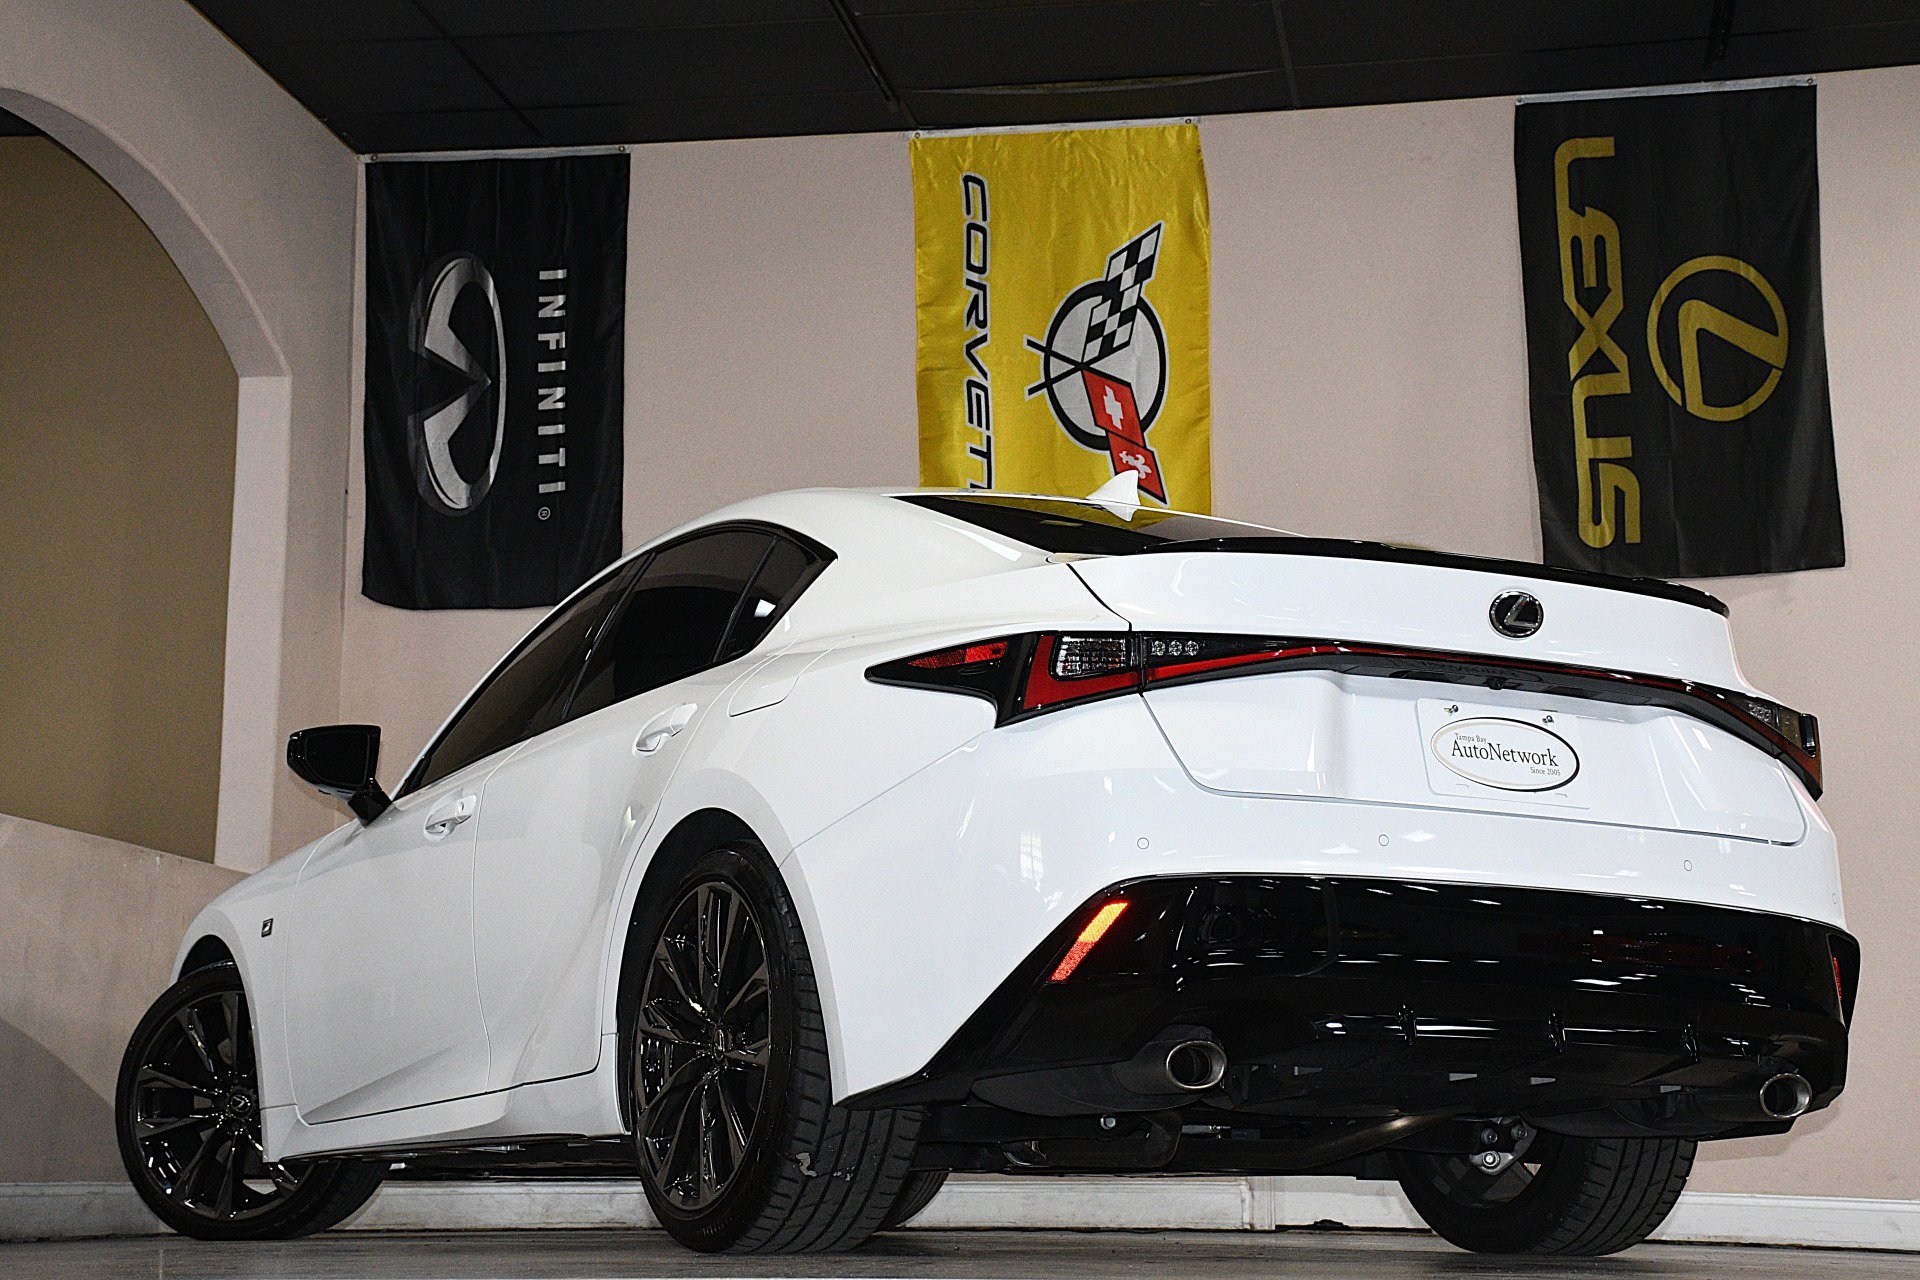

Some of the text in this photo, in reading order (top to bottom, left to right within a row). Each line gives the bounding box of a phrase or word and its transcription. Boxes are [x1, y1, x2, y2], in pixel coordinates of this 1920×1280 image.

[1554, 136, 1641, 549] LEXUS
[537, 269, 567, 494] INFINITI
[1454, 733, 1487, 744] Tampa Bay
[1451, 739, 1559, 767] AutoNetwork
[1530, 766, 1546, 775] Since
